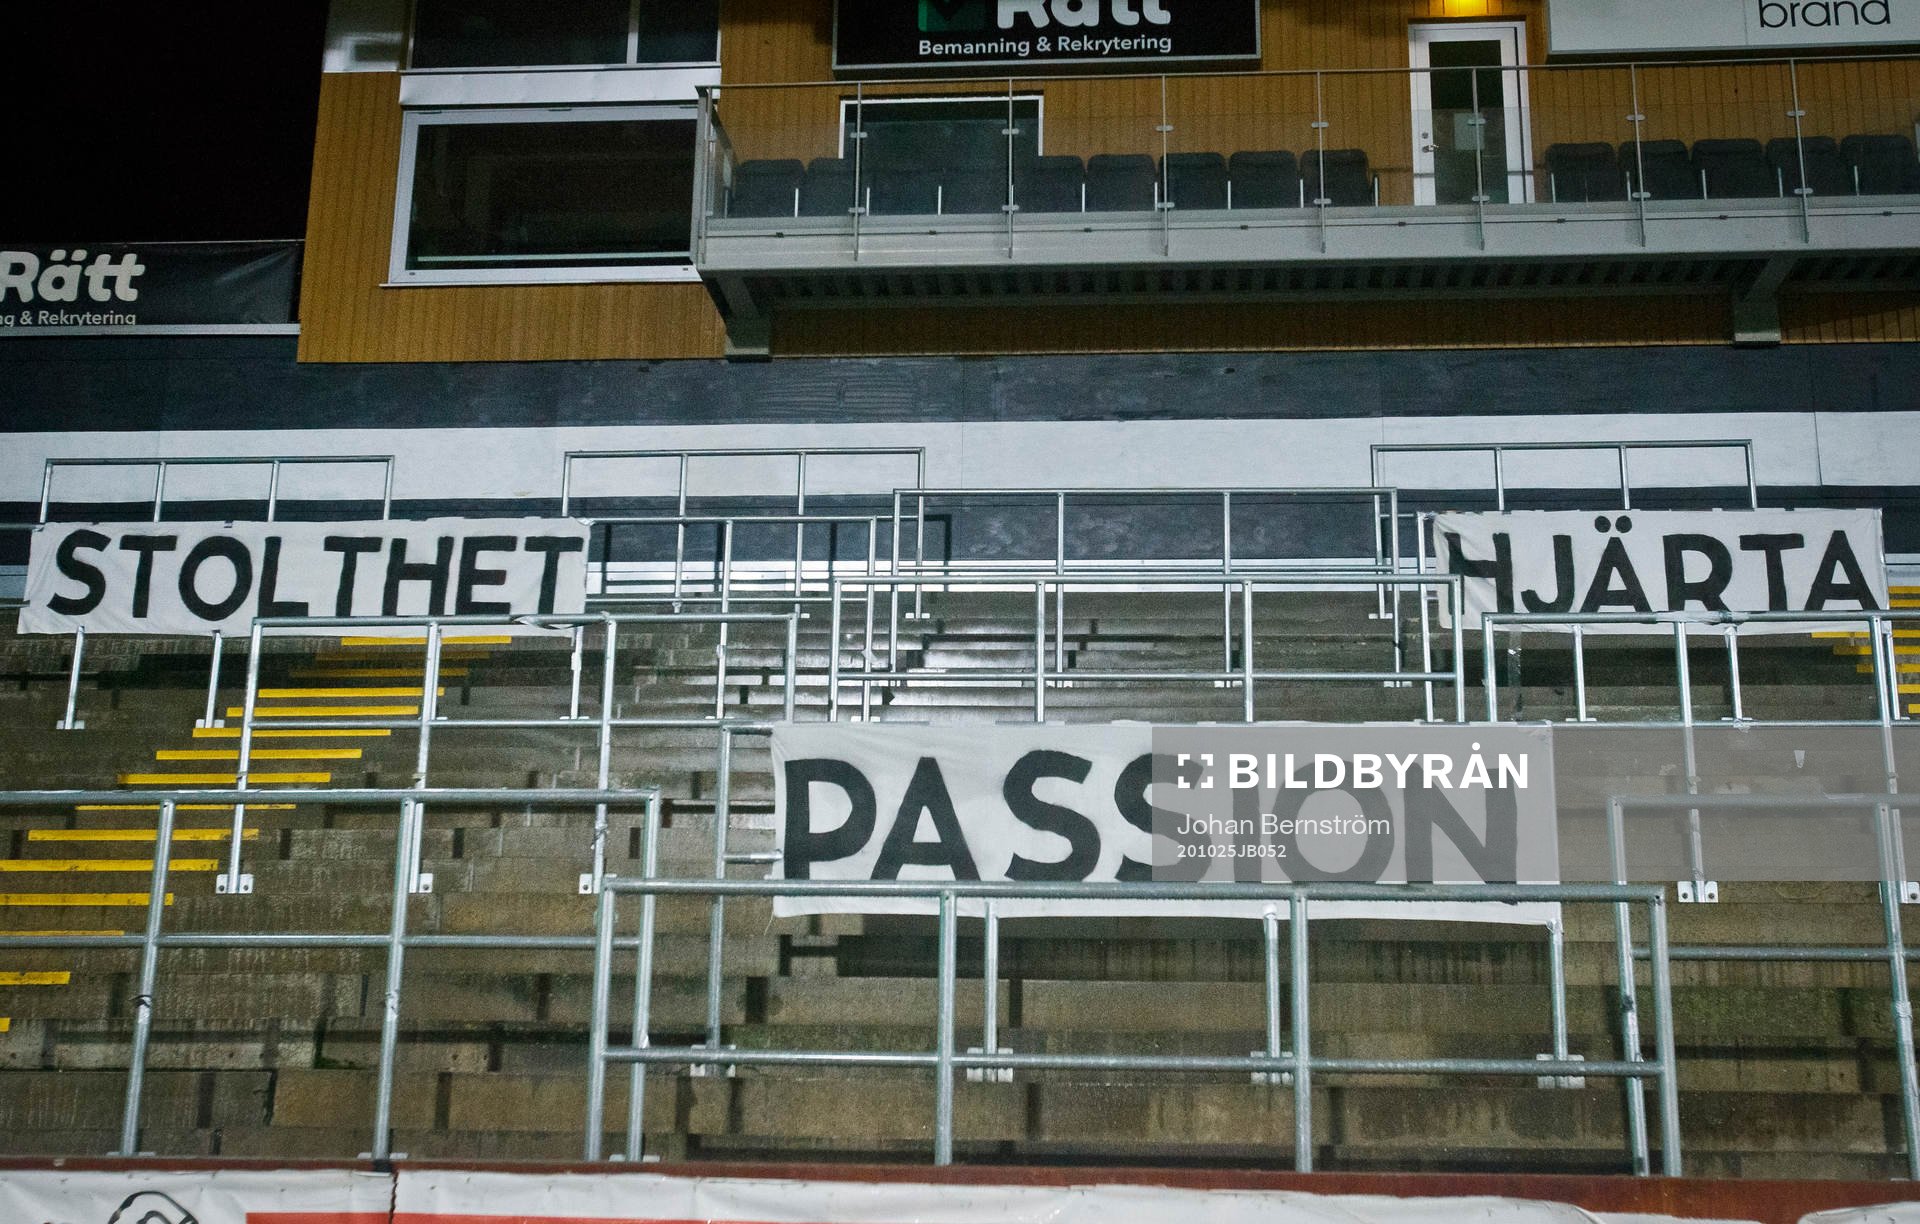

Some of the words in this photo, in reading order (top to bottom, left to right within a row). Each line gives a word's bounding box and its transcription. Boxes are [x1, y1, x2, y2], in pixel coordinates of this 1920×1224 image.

[1758, 0, 1891, 28] brand
[918, 38, 1030, 57] Bemanning
[1036, 36, 1051, 52] &
[1058, 35, 1172, 55] Rekrytering
[0, 249, 146, 303] Rätt
[20, 310, 33, 325] &
[38, 309, 136, 326] Rekrytering
[46, 528, 583, 621] STOLTHET
[1444, 515, 1882, 615] HJÄRTA
[784, 750, 1518, 883] PASSION
